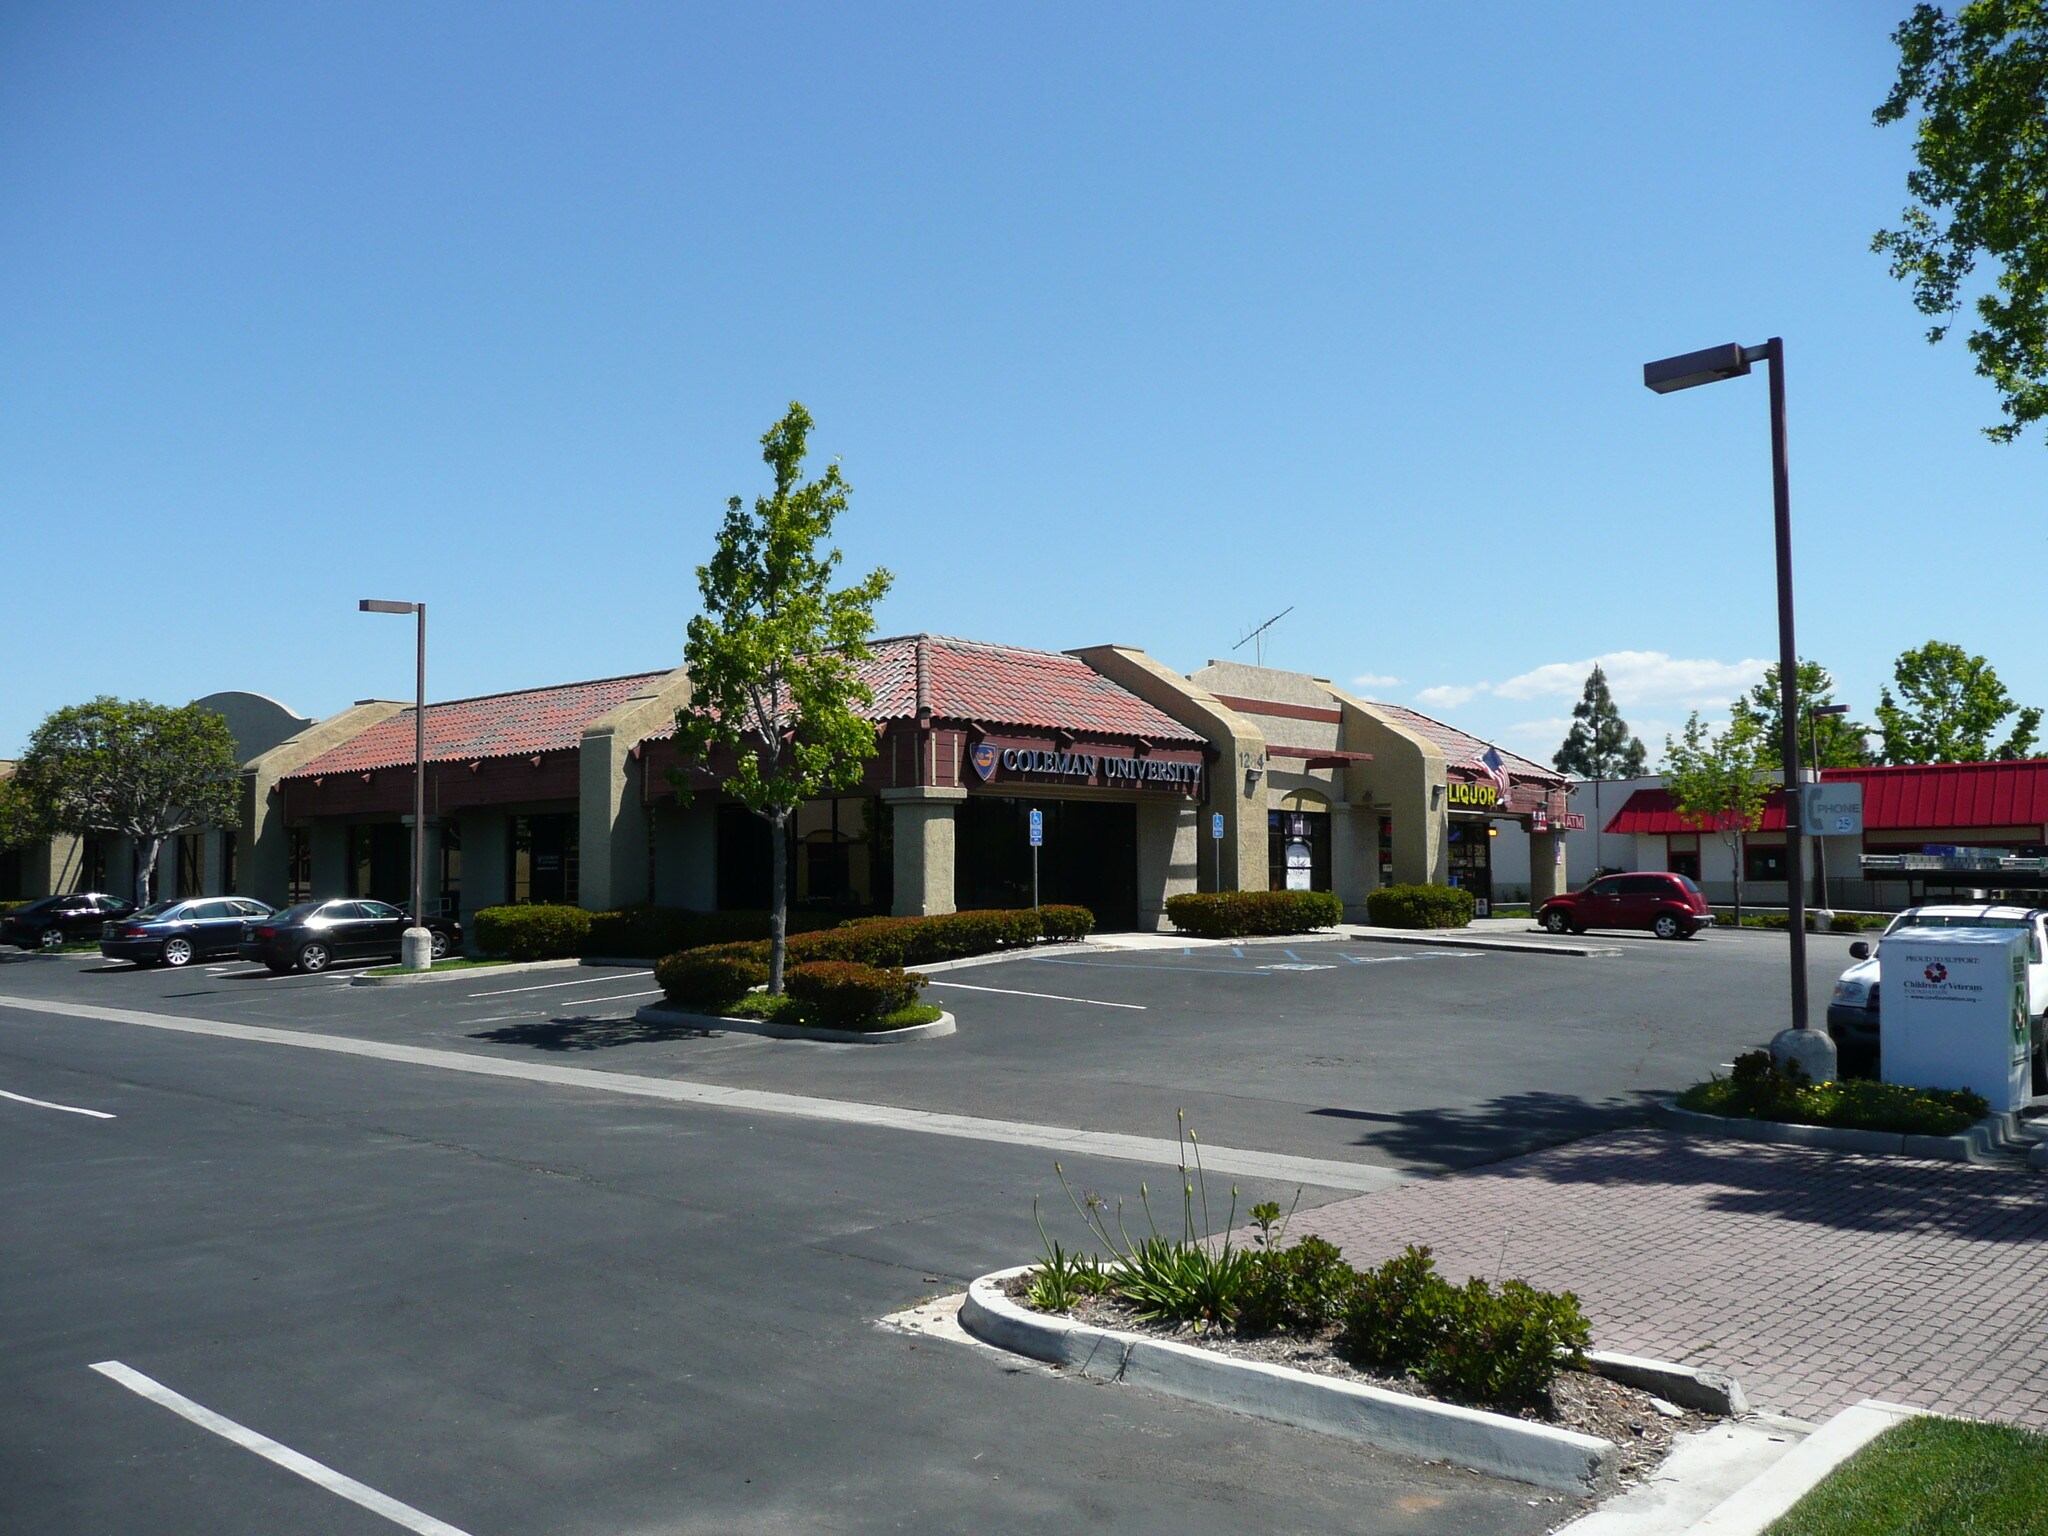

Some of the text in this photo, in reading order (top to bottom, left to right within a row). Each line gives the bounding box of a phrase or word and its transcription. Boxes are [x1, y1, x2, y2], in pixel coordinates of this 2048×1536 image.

[1003, 748, 1202, 783] COLEMAN UNIVERSITY
[1448, 783, 1496, 805] LIQUOR
[1817, 803, 1860, 814] PHONE
[1566, 815, 1584, 829] ATM
[1903, 981, 1983, 991] Children of Veterans
